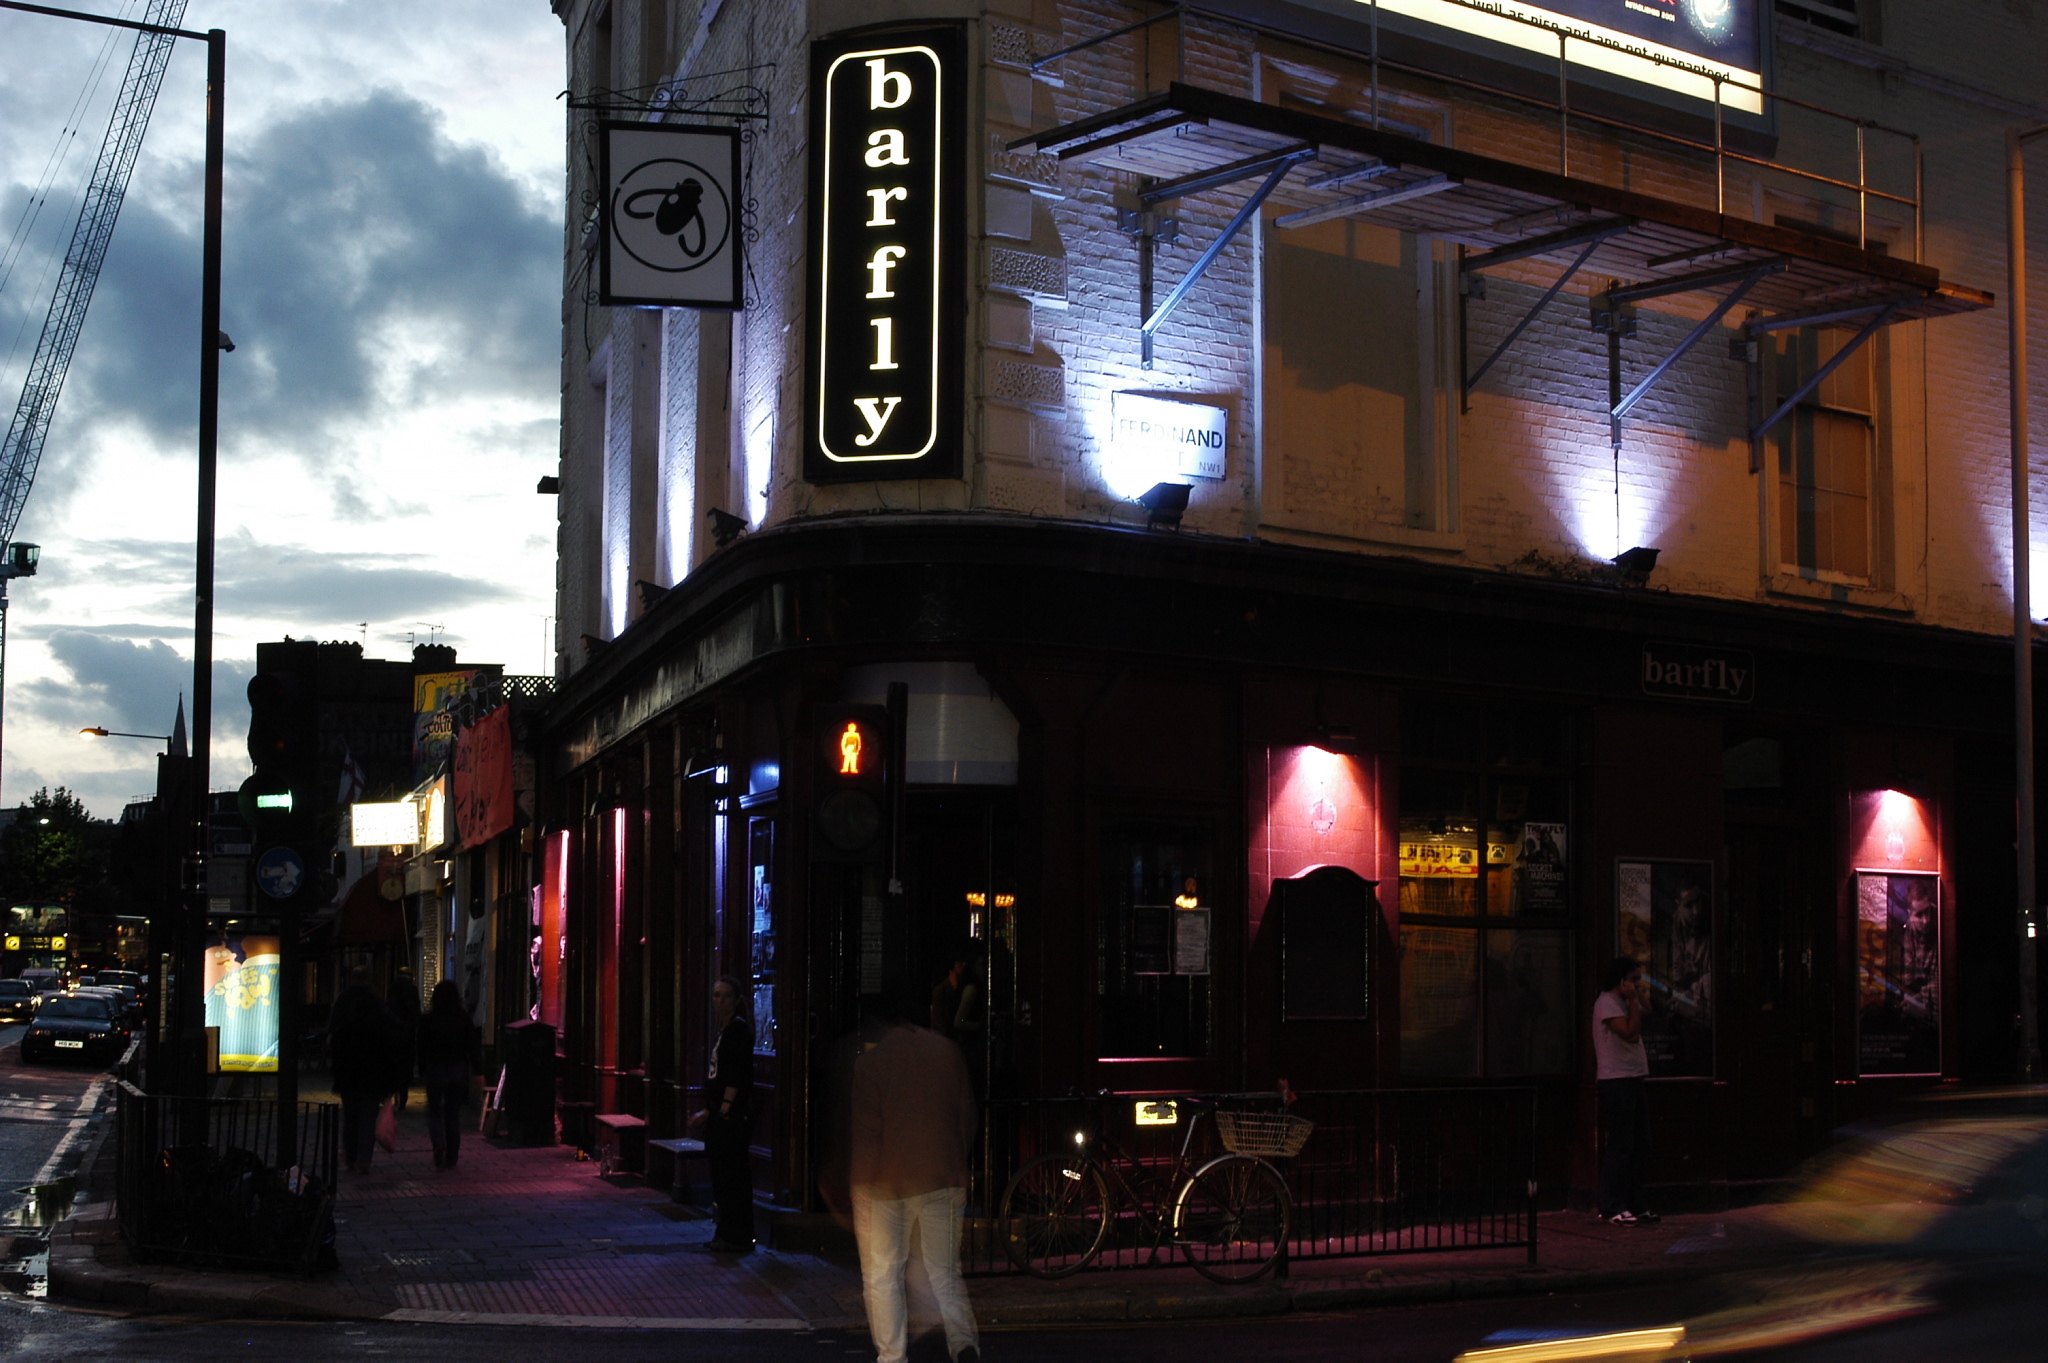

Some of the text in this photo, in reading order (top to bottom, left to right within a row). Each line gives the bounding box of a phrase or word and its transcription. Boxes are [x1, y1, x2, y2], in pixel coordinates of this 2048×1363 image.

[854, 58, 912, 447] barfly
[1199, 461, 1220, 474] NW1
[1644, 651, 1748, 696] barfly
